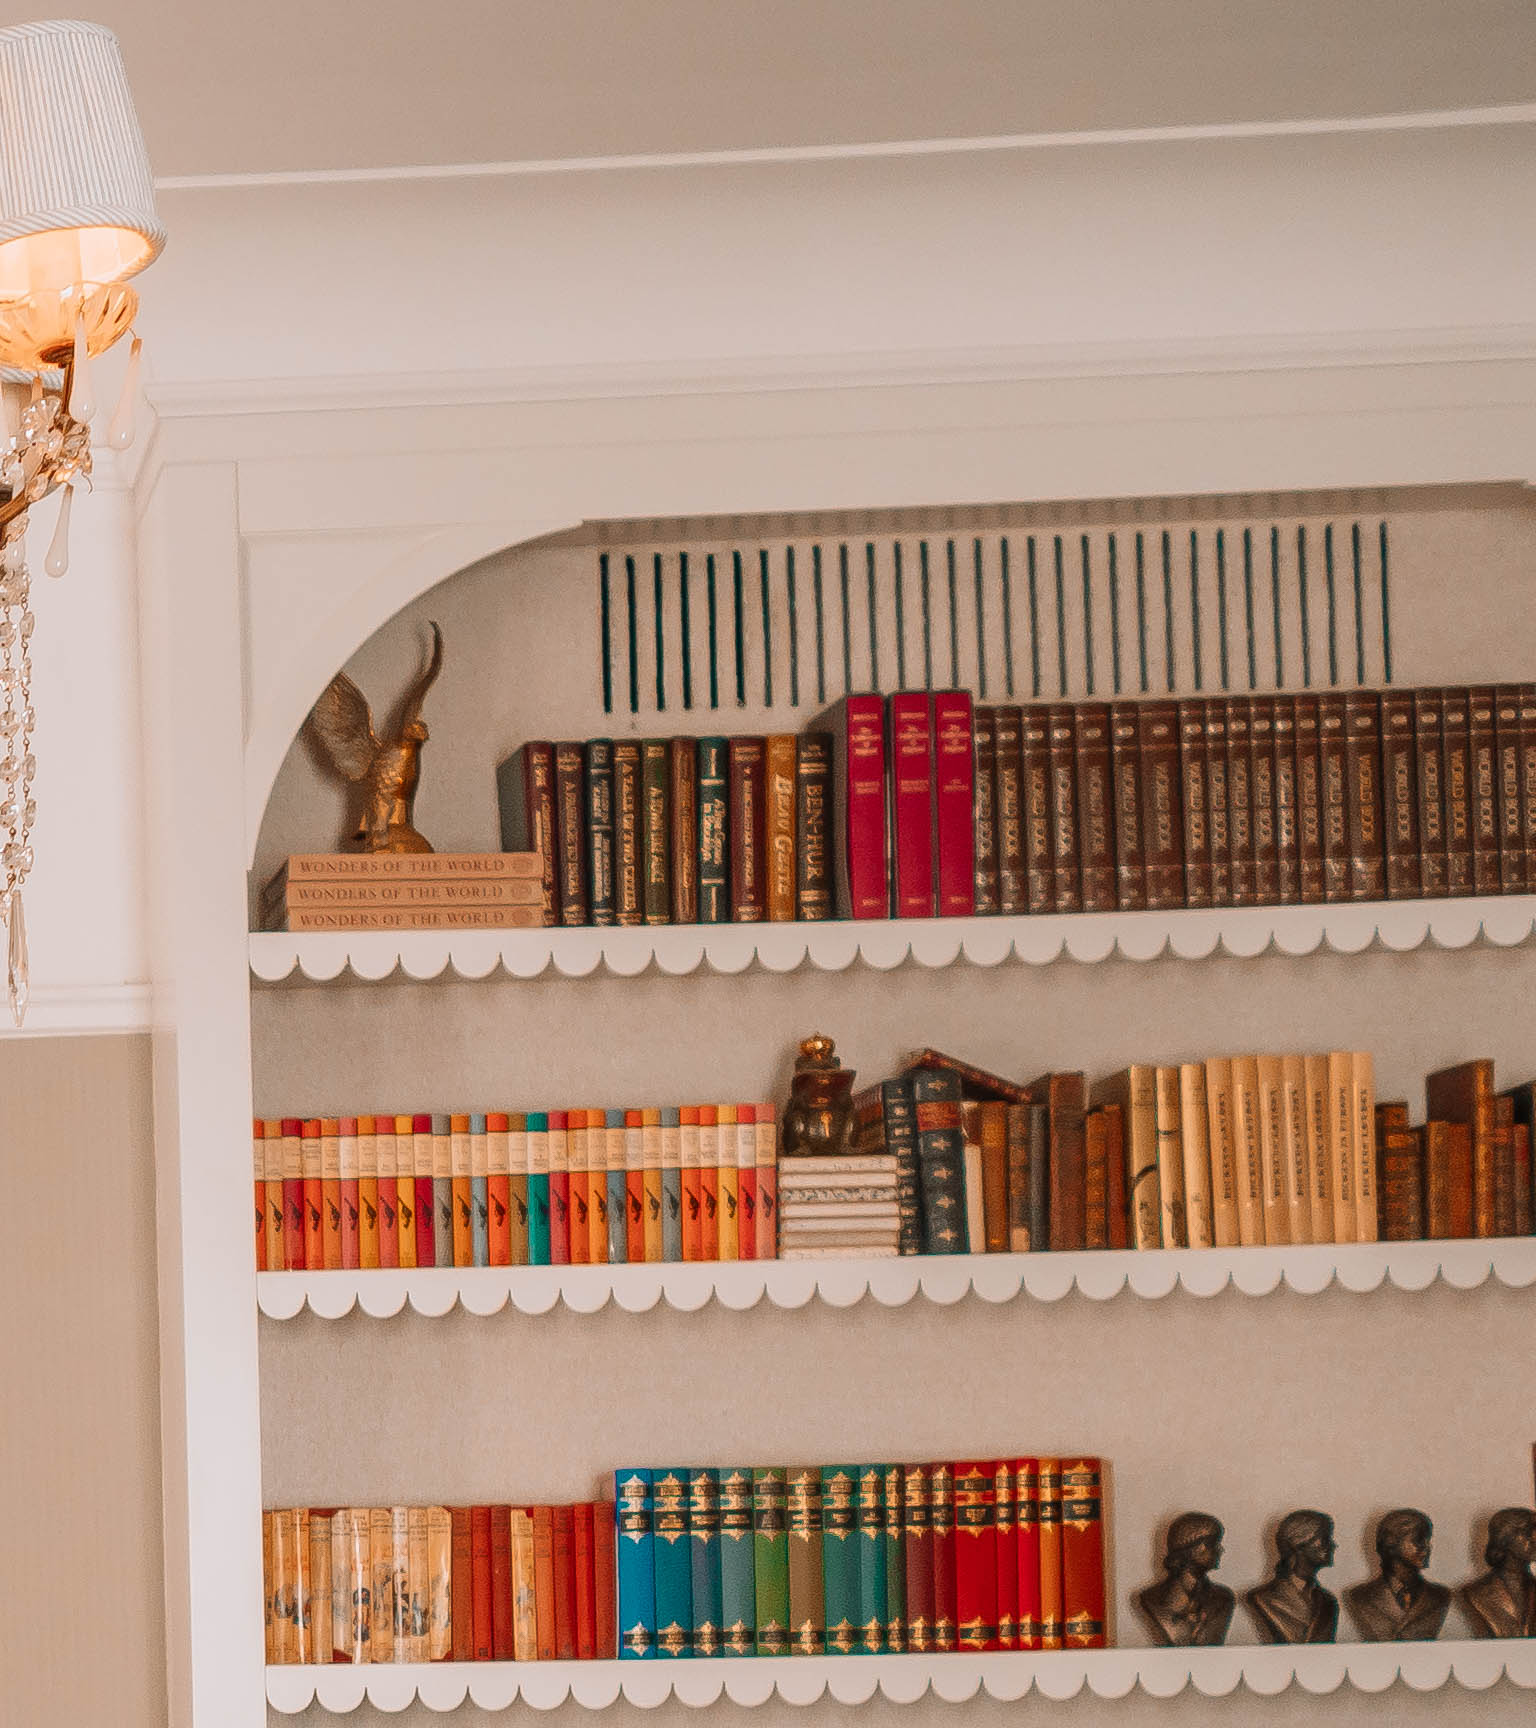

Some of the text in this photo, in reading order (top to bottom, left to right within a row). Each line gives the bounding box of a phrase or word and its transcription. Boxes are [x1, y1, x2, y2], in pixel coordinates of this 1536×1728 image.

[806, 784, 824, 881] BEN-HUR
[300, 859, 504, 873] WONDERS OF THE WORLD
[298, 886, 504, 900] WONDERS OF THE WORLD
[299, 912, 505, 927] WONDERS OF THE WORLD
